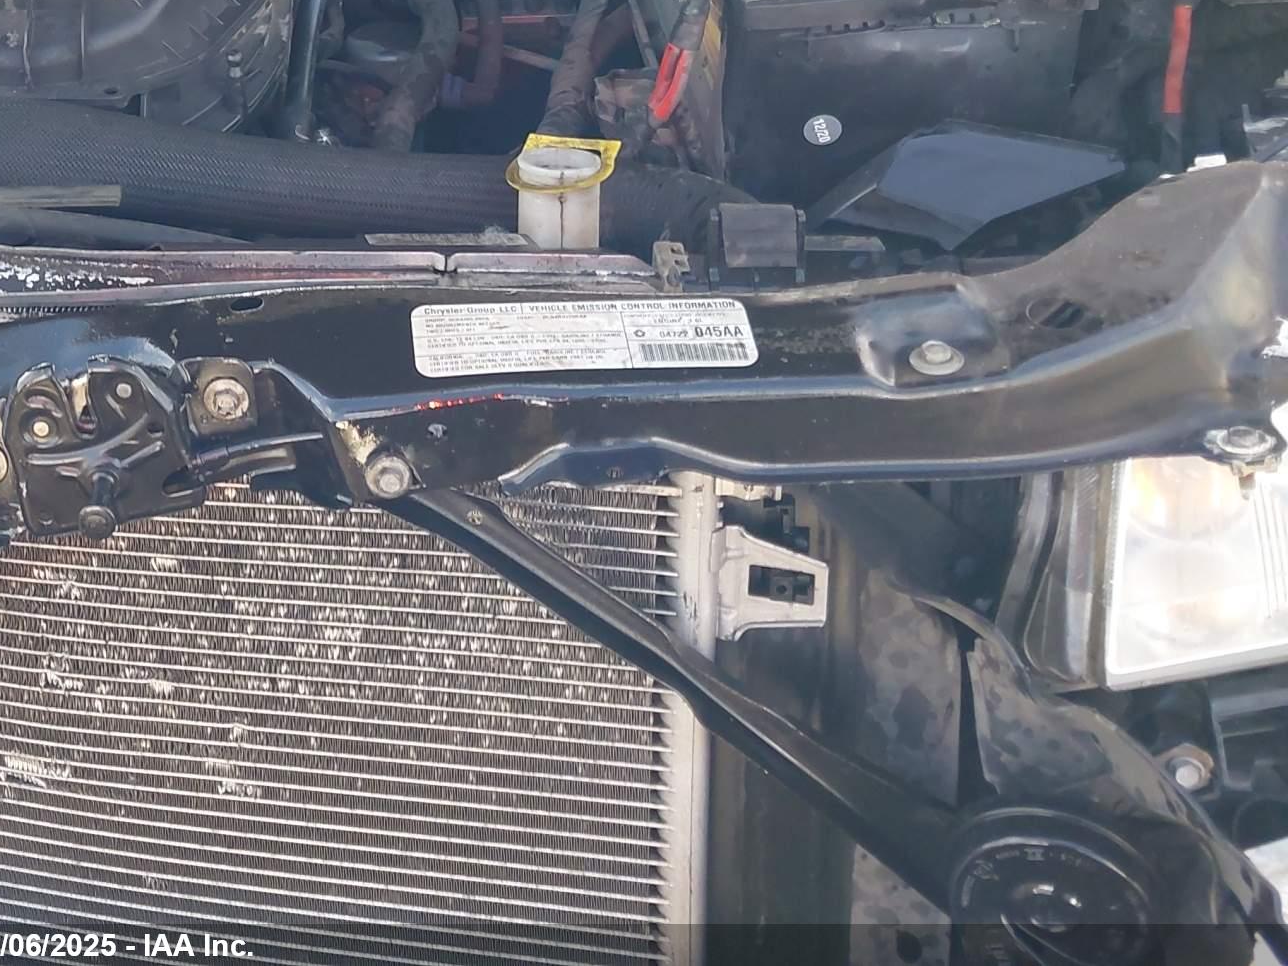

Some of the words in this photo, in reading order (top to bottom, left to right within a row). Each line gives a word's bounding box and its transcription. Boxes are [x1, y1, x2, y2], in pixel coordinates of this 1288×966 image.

[812, 118, 831, 143] 12/20
[668, 301, 736, 309] INFORMATION
[424, 307, 463, 316] Chrysler
[466, 307, 496, 315] Group
[694, 326, 743, 338] 045AA
